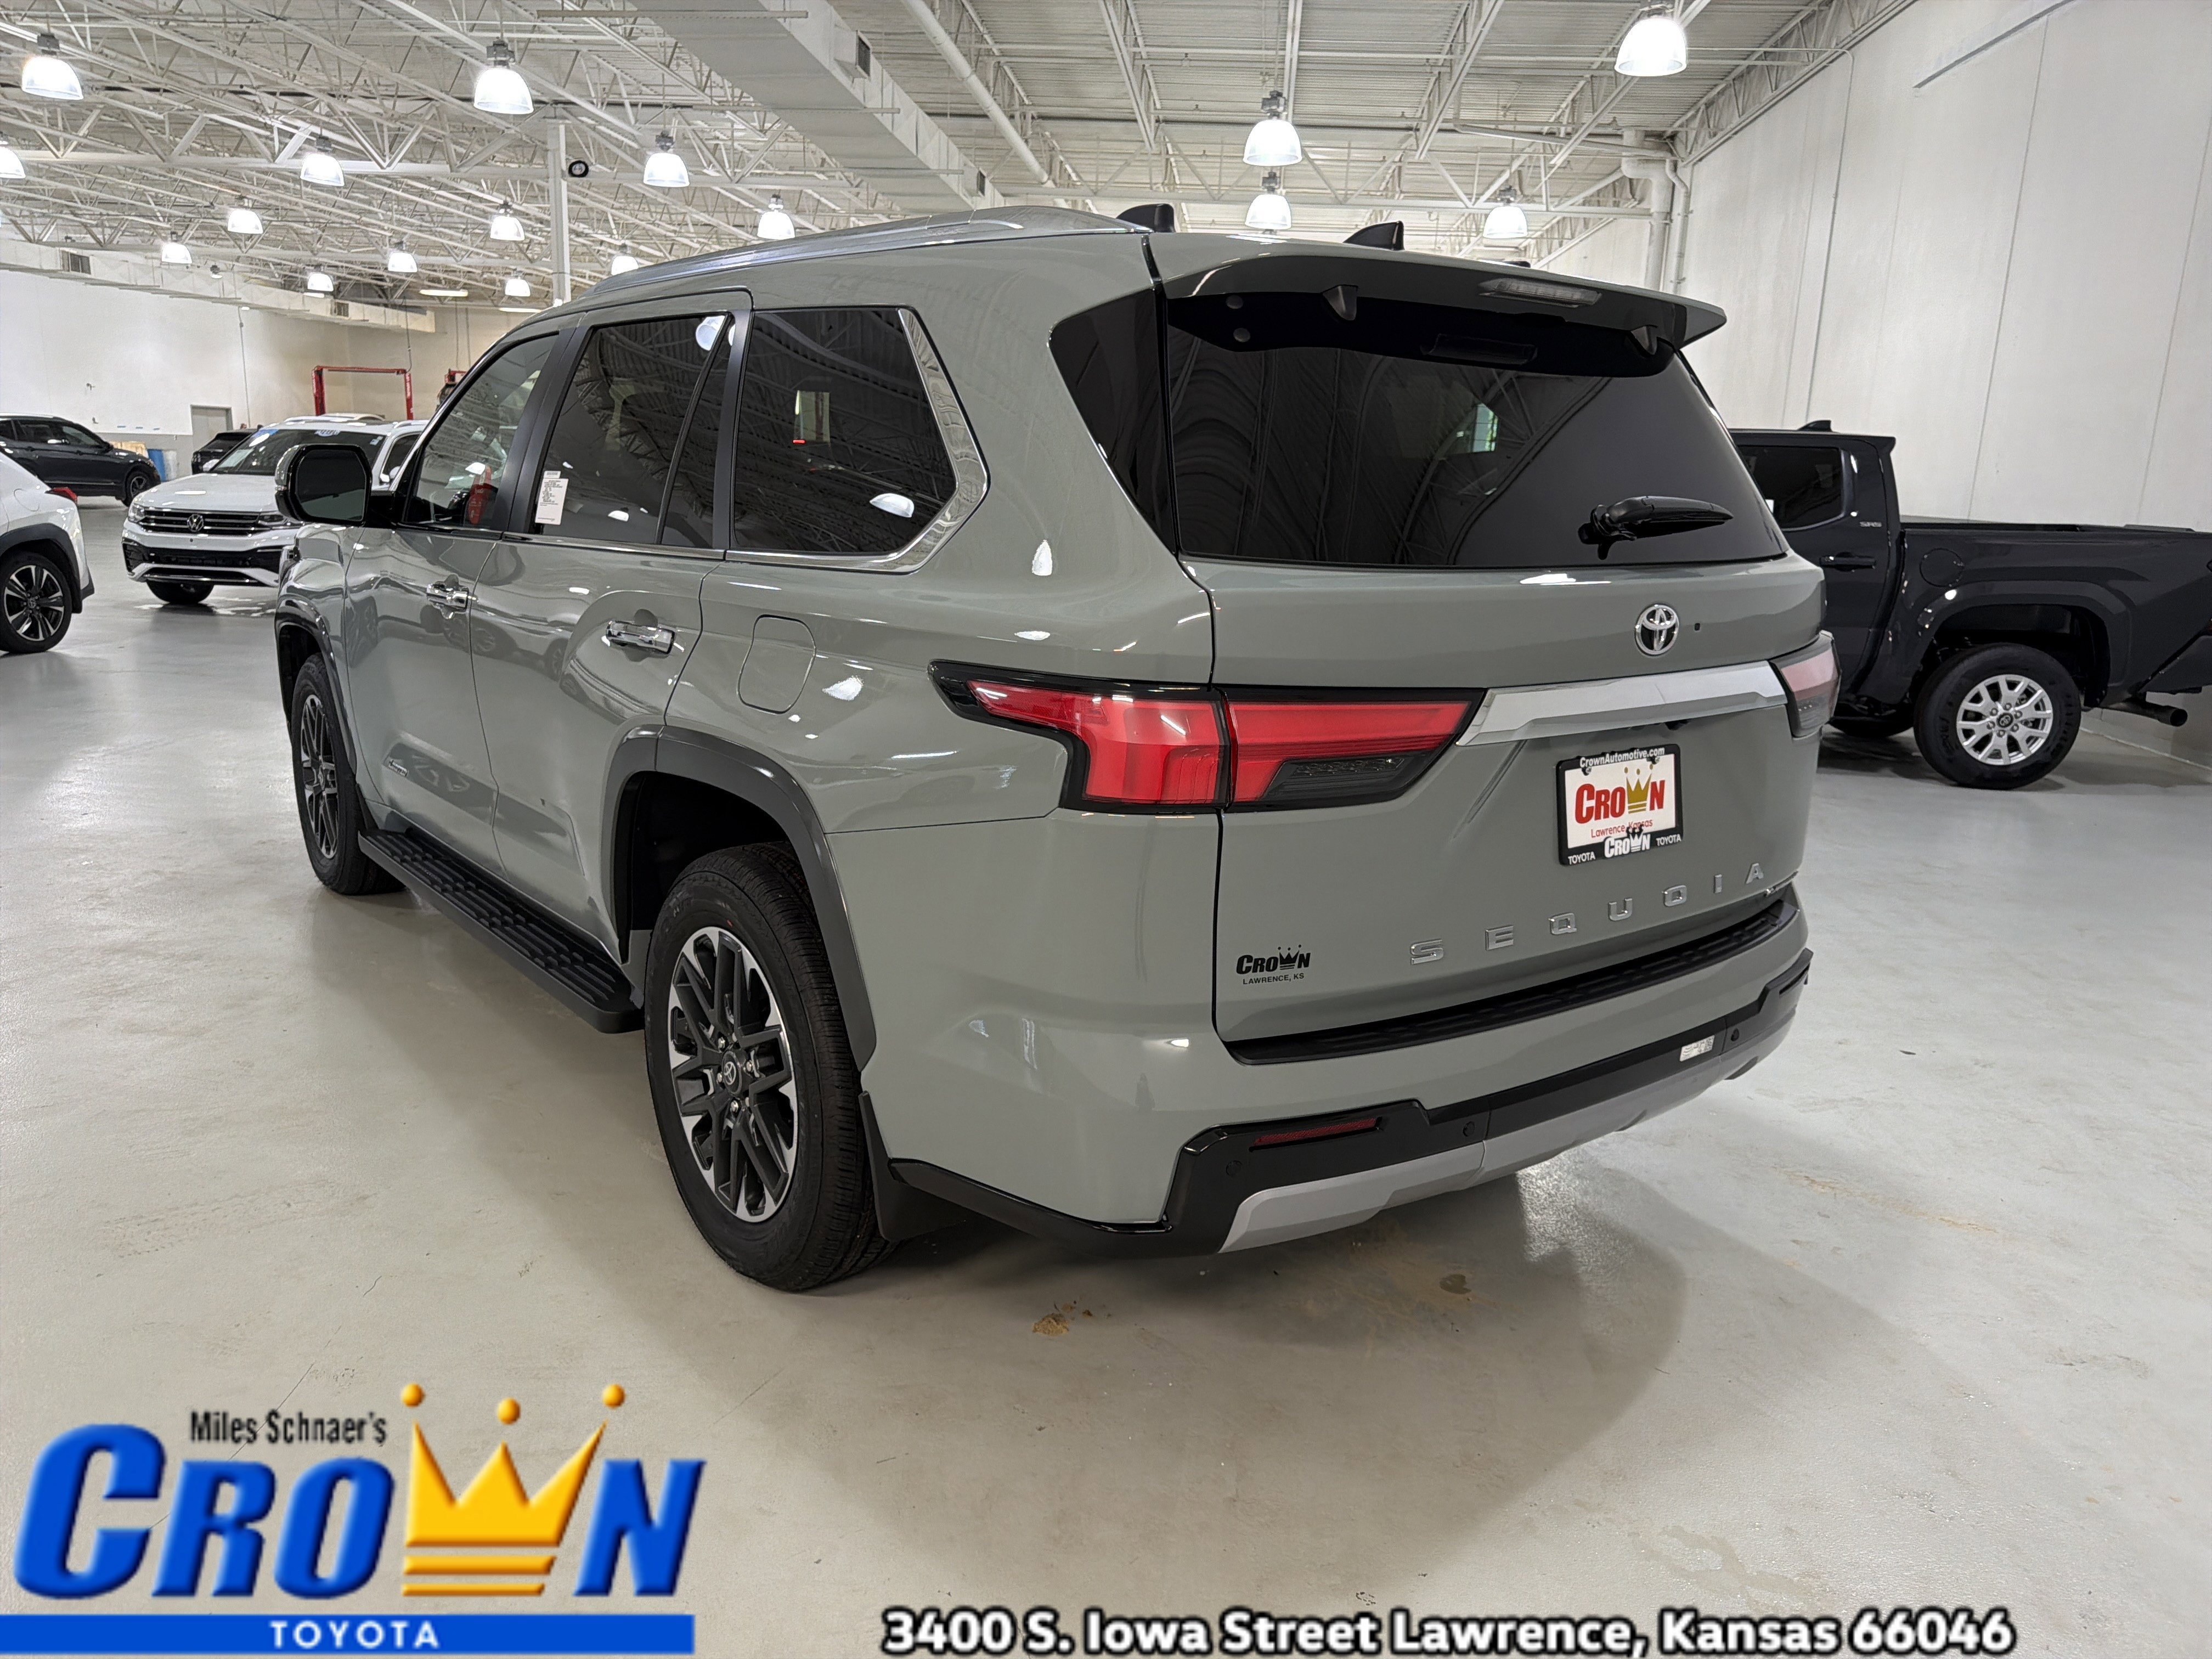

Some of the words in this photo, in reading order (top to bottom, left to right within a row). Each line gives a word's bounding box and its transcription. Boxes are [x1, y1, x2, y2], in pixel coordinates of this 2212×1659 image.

[1579, 747, 1665, 768] CrownAutomotive.com
[1590, 826, 1626, 838] Lawrence
[1656, 834, 1682, 847] TOYOTA
[1567, 851, 1596, 865] TOYOTA
[1410, 862, 1764, 964] SEQUOIA
[1243, 974, 1291, 985] LAWRENCE,
